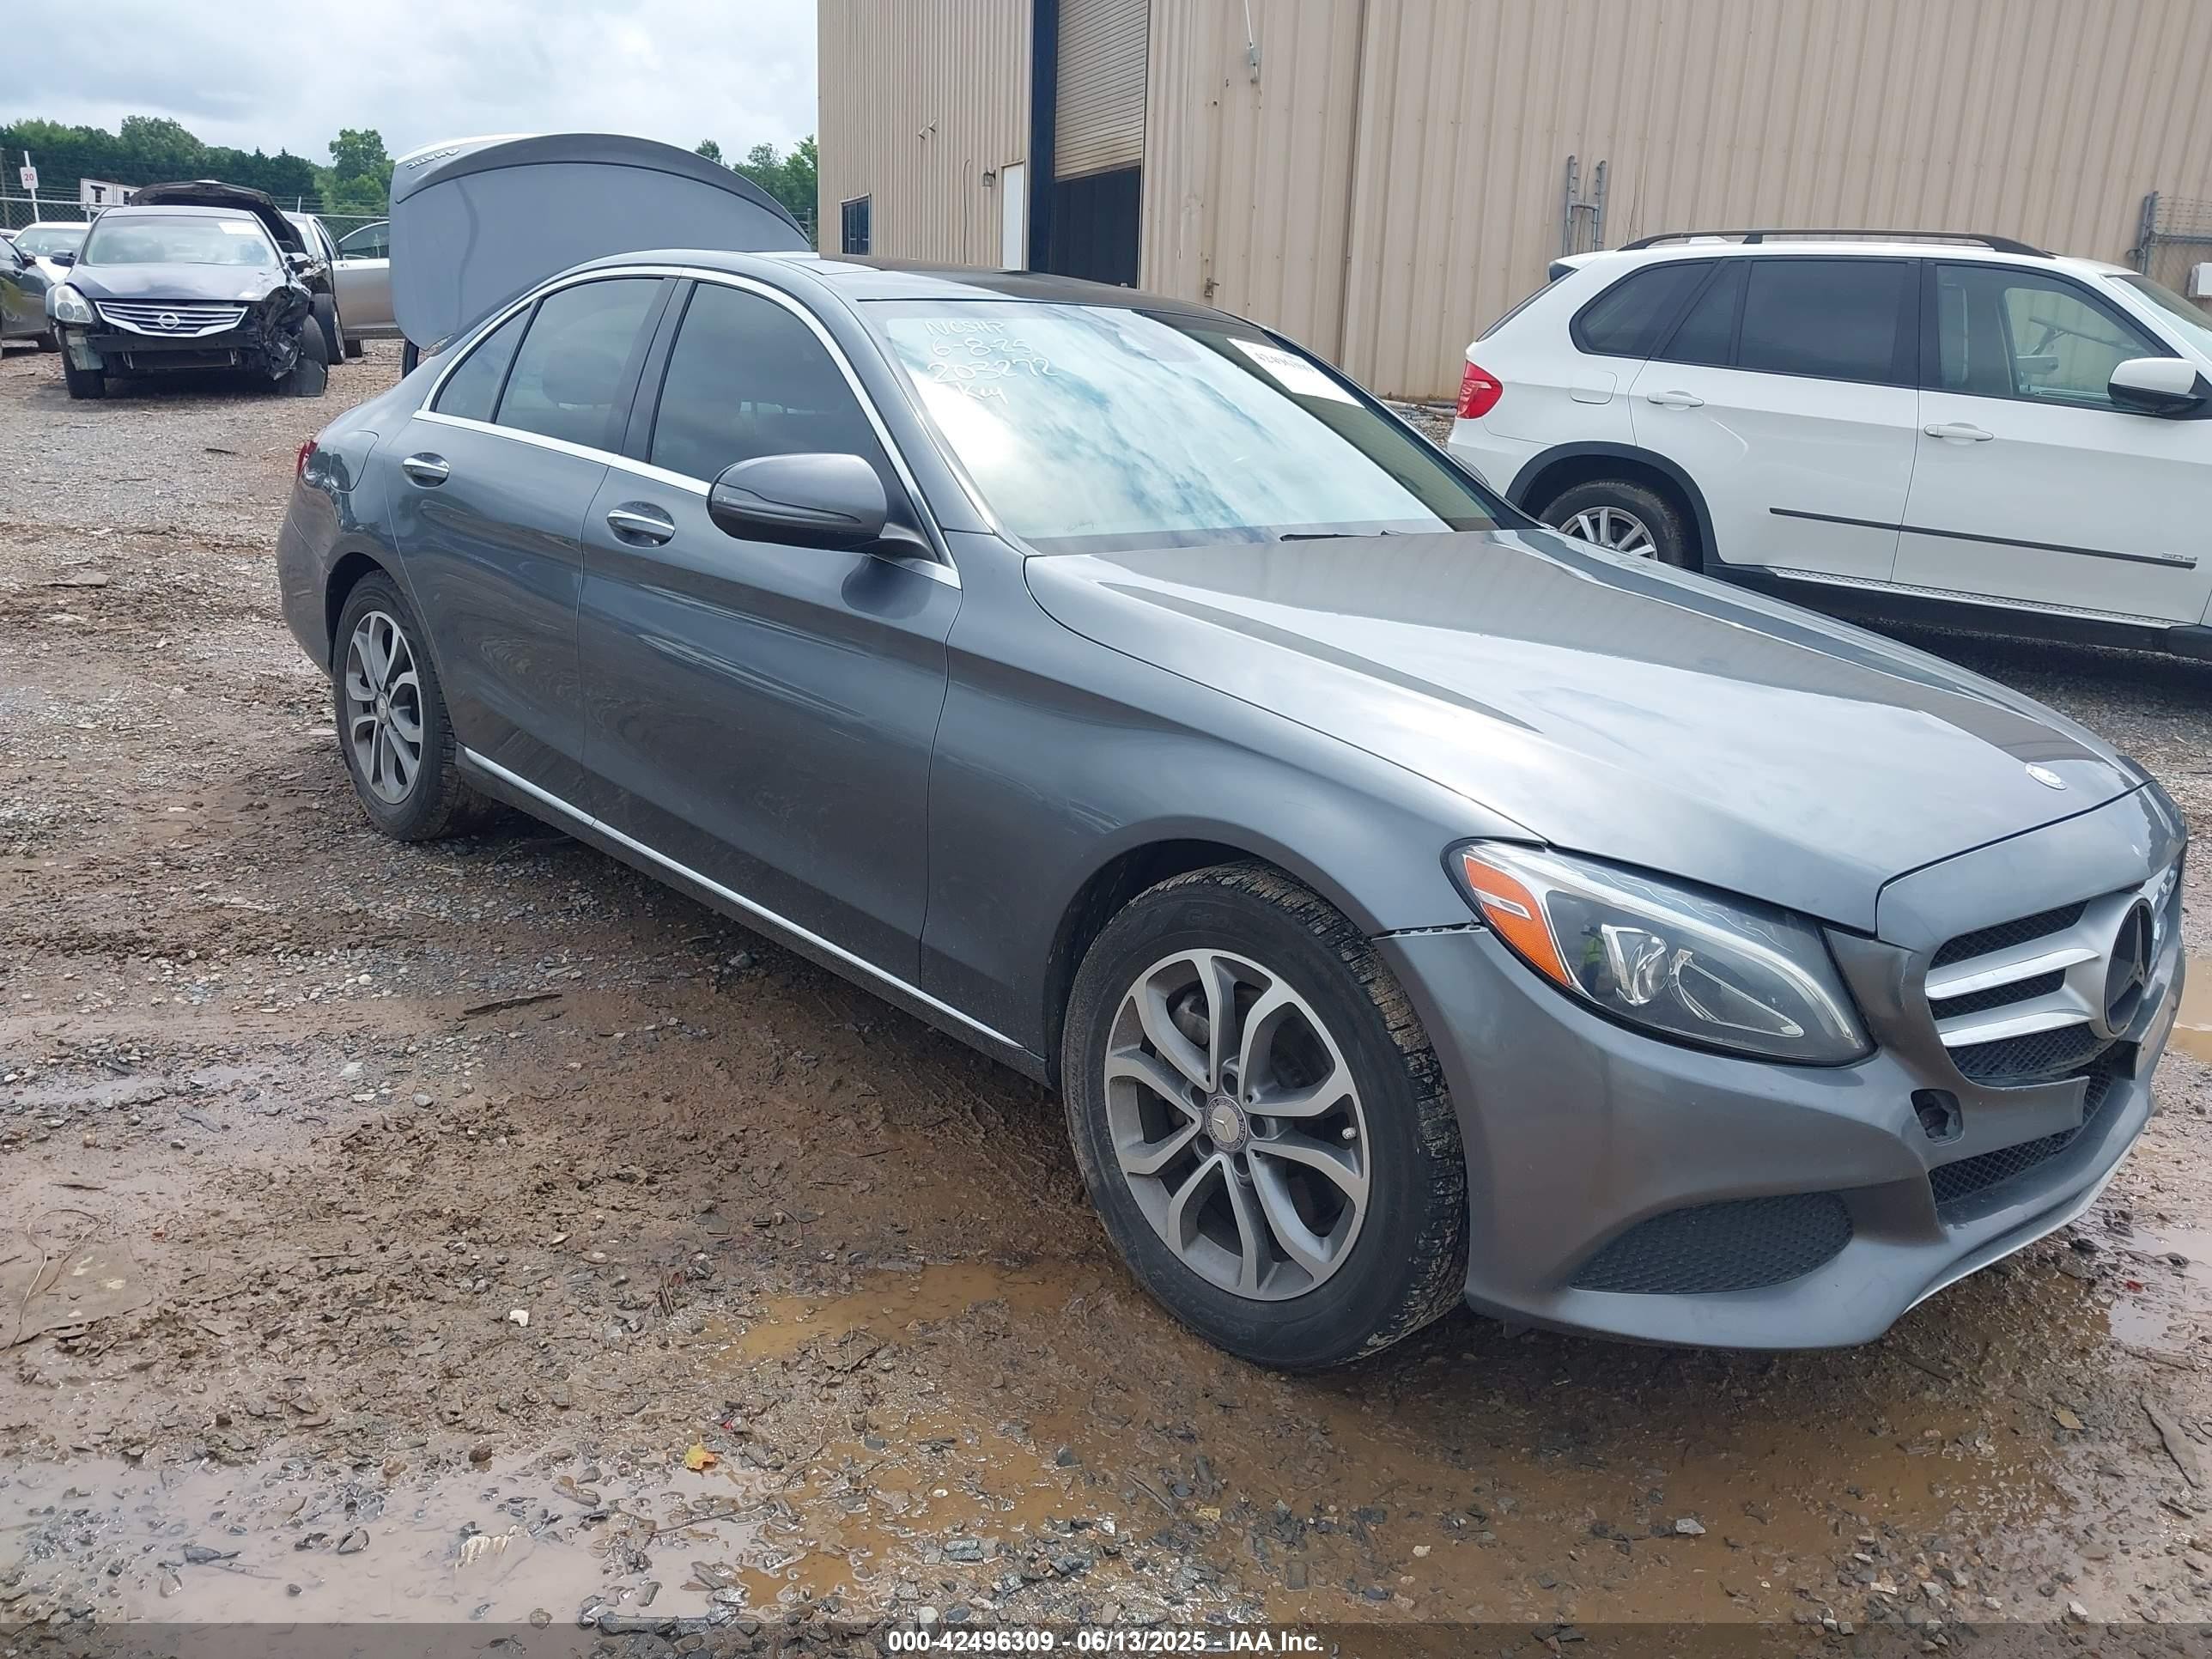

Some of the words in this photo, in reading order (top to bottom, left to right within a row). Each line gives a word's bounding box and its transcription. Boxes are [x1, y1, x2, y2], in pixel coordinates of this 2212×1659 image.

[24, 173, 34, 181] 20
[933, 337, 1032, 357] 6-8-25
[927, 357, 1058, 383] 203272
